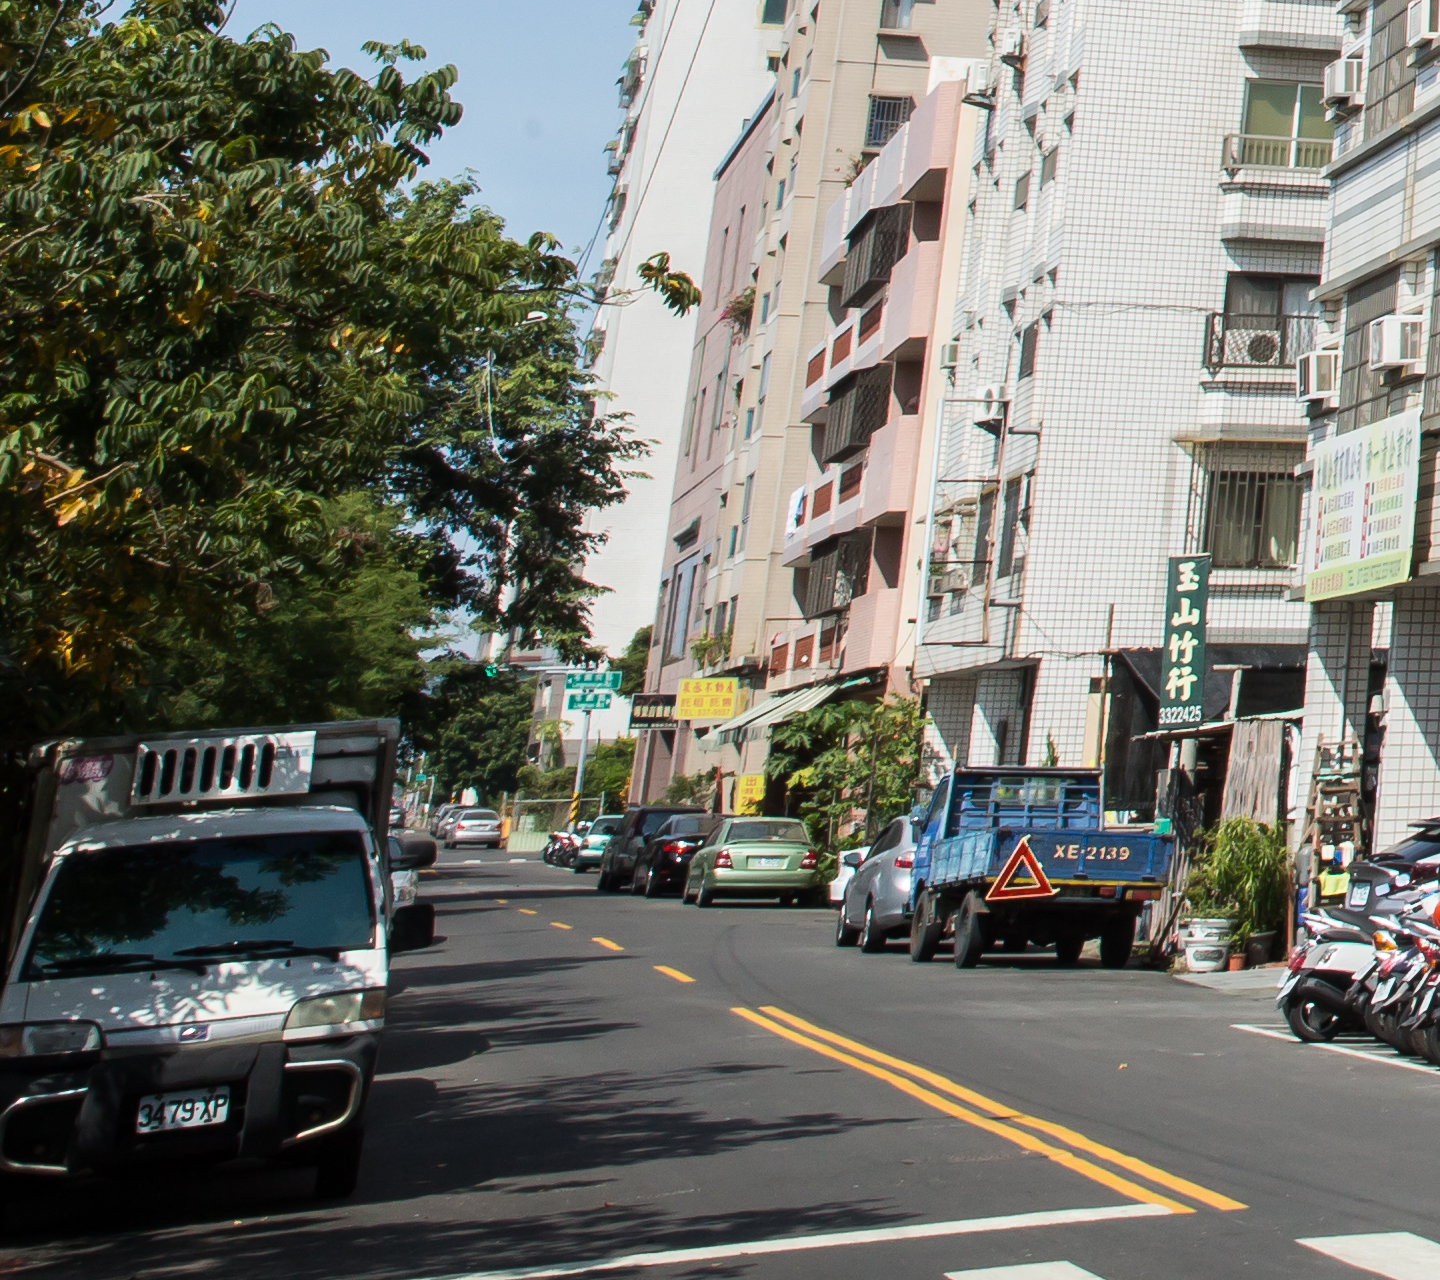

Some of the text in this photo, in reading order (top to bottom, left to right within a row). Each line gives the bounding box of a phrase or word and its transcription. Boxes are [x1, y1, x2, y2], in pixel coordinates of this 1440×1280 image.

[1165, 561, 1200, 701] 玉山竹行
[1159, 705, 1202, 724] 3322425
